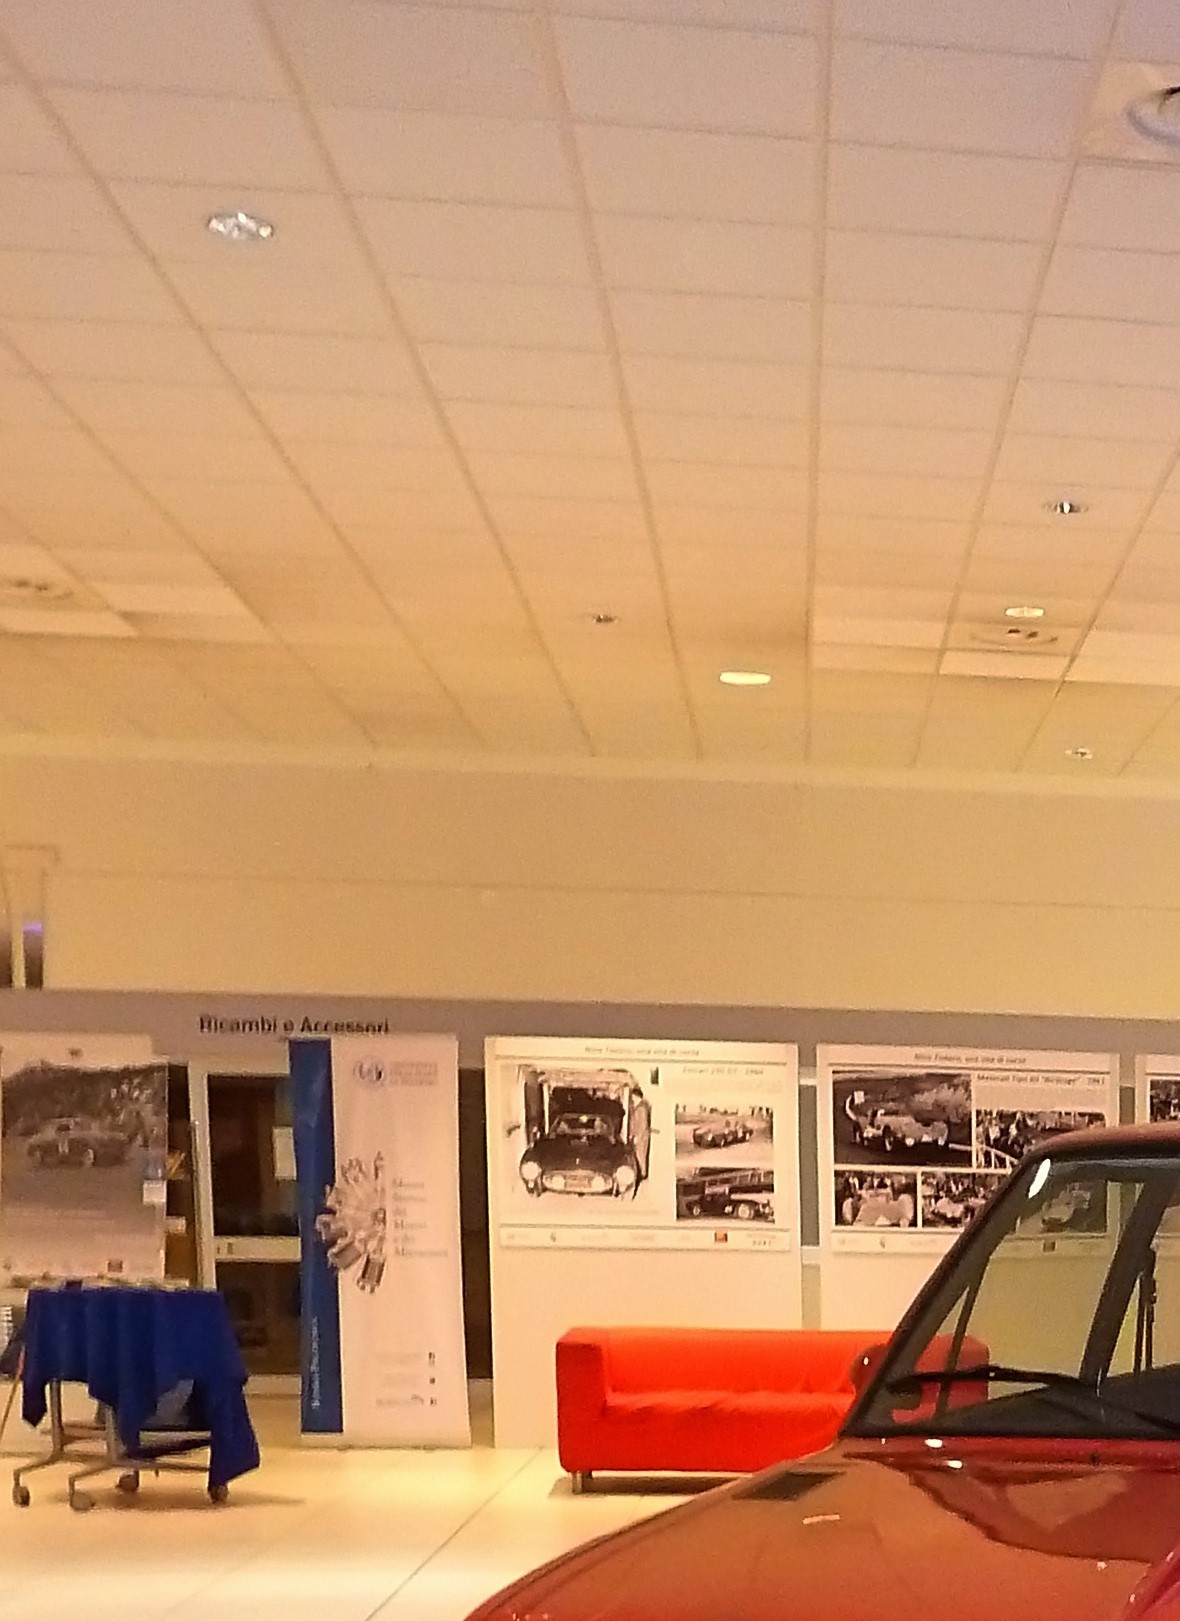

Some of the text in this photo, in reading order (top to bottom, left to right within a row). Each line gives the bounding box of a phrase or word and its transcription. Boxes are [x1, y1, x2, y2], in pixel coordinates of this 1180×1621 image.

[200, 1015, 389, 1033] Ricambi e Accessori
